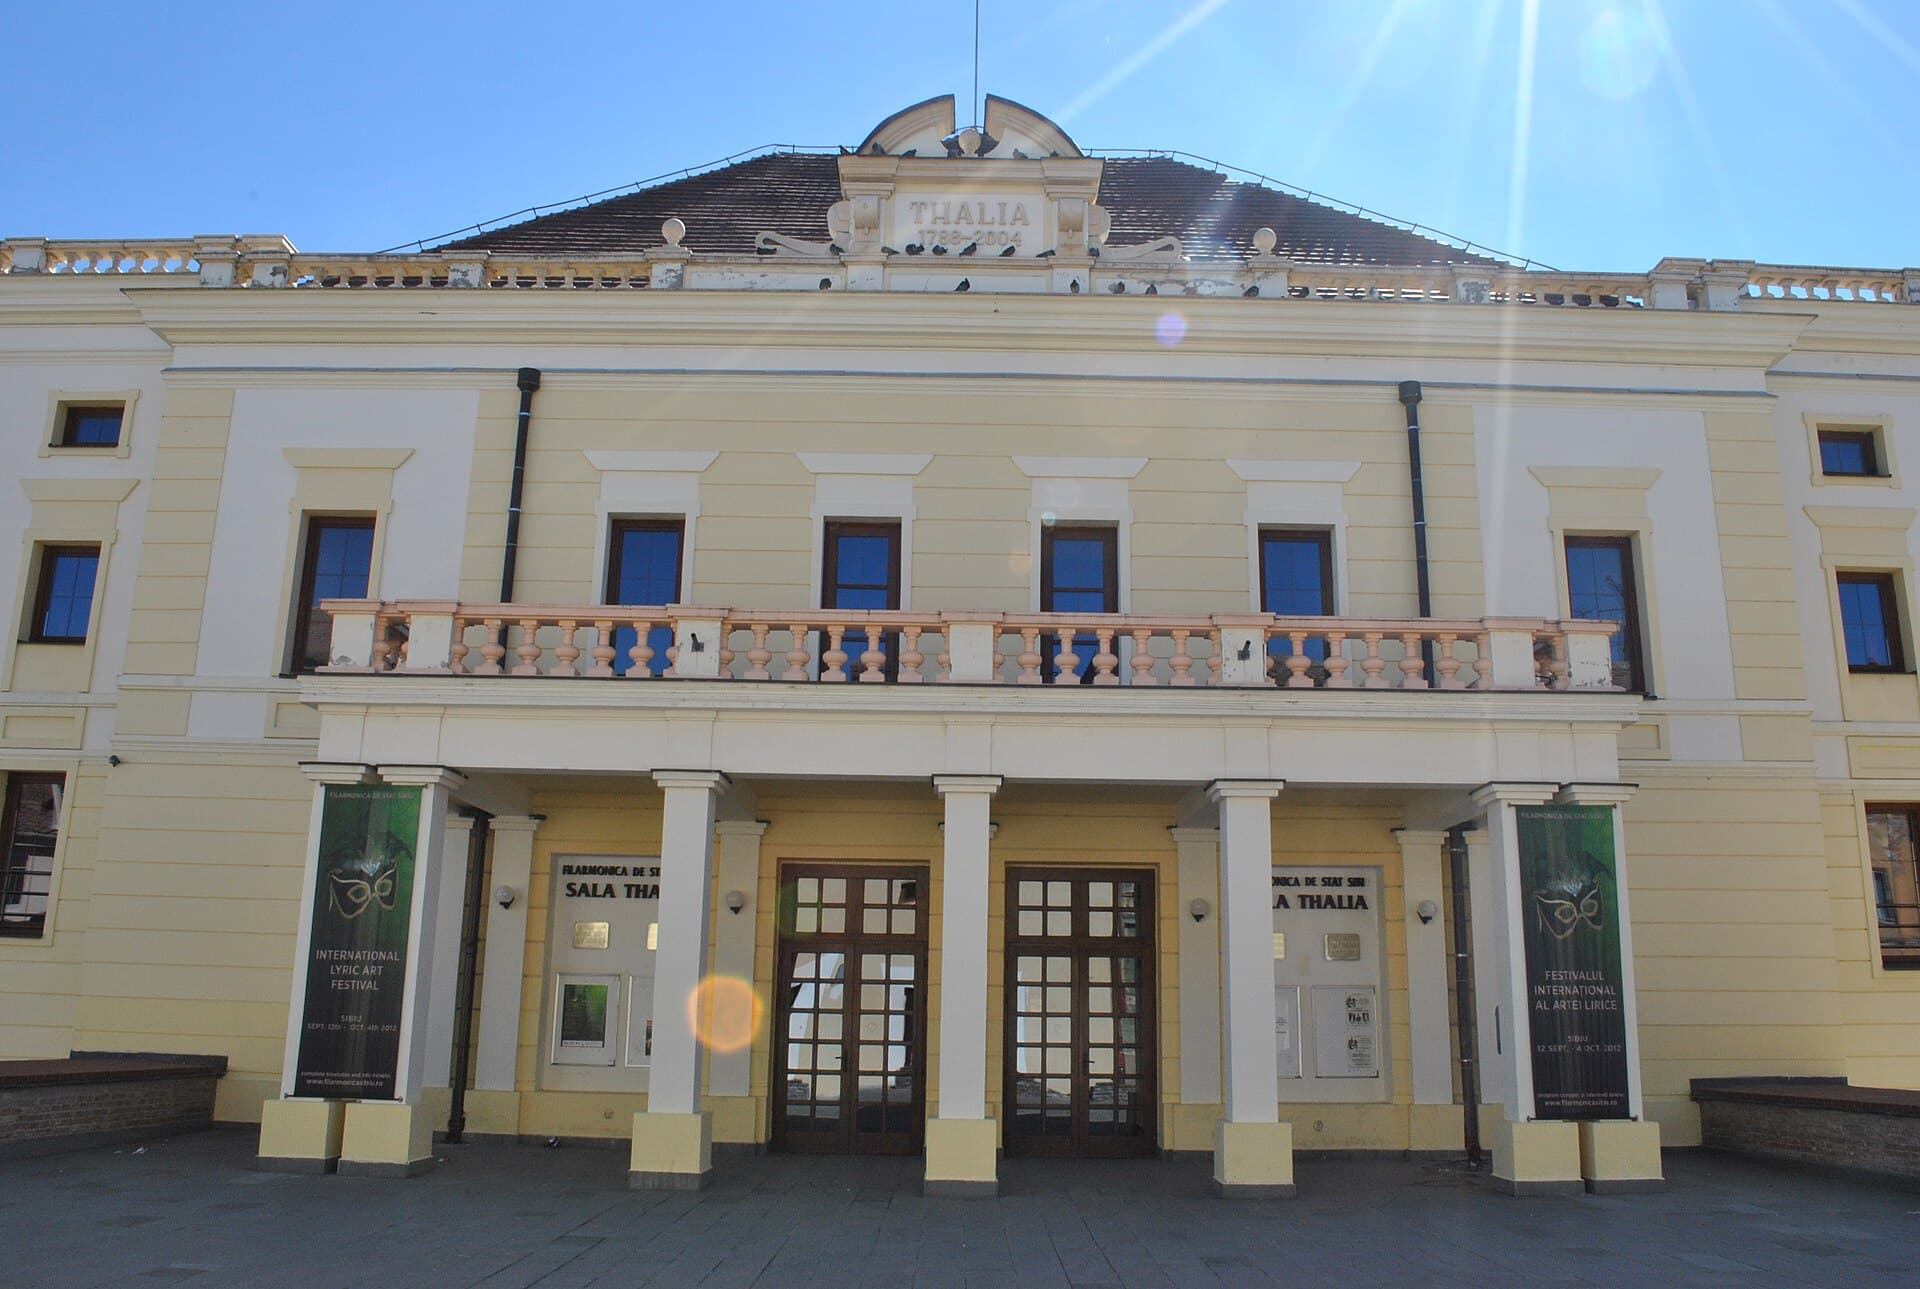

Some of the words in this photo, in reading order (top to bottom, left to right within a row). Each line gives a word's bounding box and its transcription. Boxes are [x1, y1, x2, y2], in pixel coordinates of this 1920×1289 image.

[909, 201, 1030, 226] THALIA
[562, 865, 628, 876] FILARMONICA
[632, 867, 645, 876] DE
[649, 867, 661, 877] ST
[1304, 877, 1318, 886] DE
[1321, 877, 1343, 887] STAT
[565, 882, 616, 898] SALA
[624, 884, 660, 899] THA
[1298, 894, 1369, 909] THALIA
[316, 949, 400, 961] INTERNATIONAL
[330, 965, 360, 976] LYRIC
[362, 965, 384, 976] ART
[1545, 970, 1605, 981] FESTIVALUL
[331, 979, 379, 991] FESTIVAL
[1535, 1000, 1550, 1010] AL
[1553, 1000, 1582, 1011] ARTEI
[1584, 1000, 1618, 1010] LIRICE
[341, 1014, 362, 1023] SIBIU
